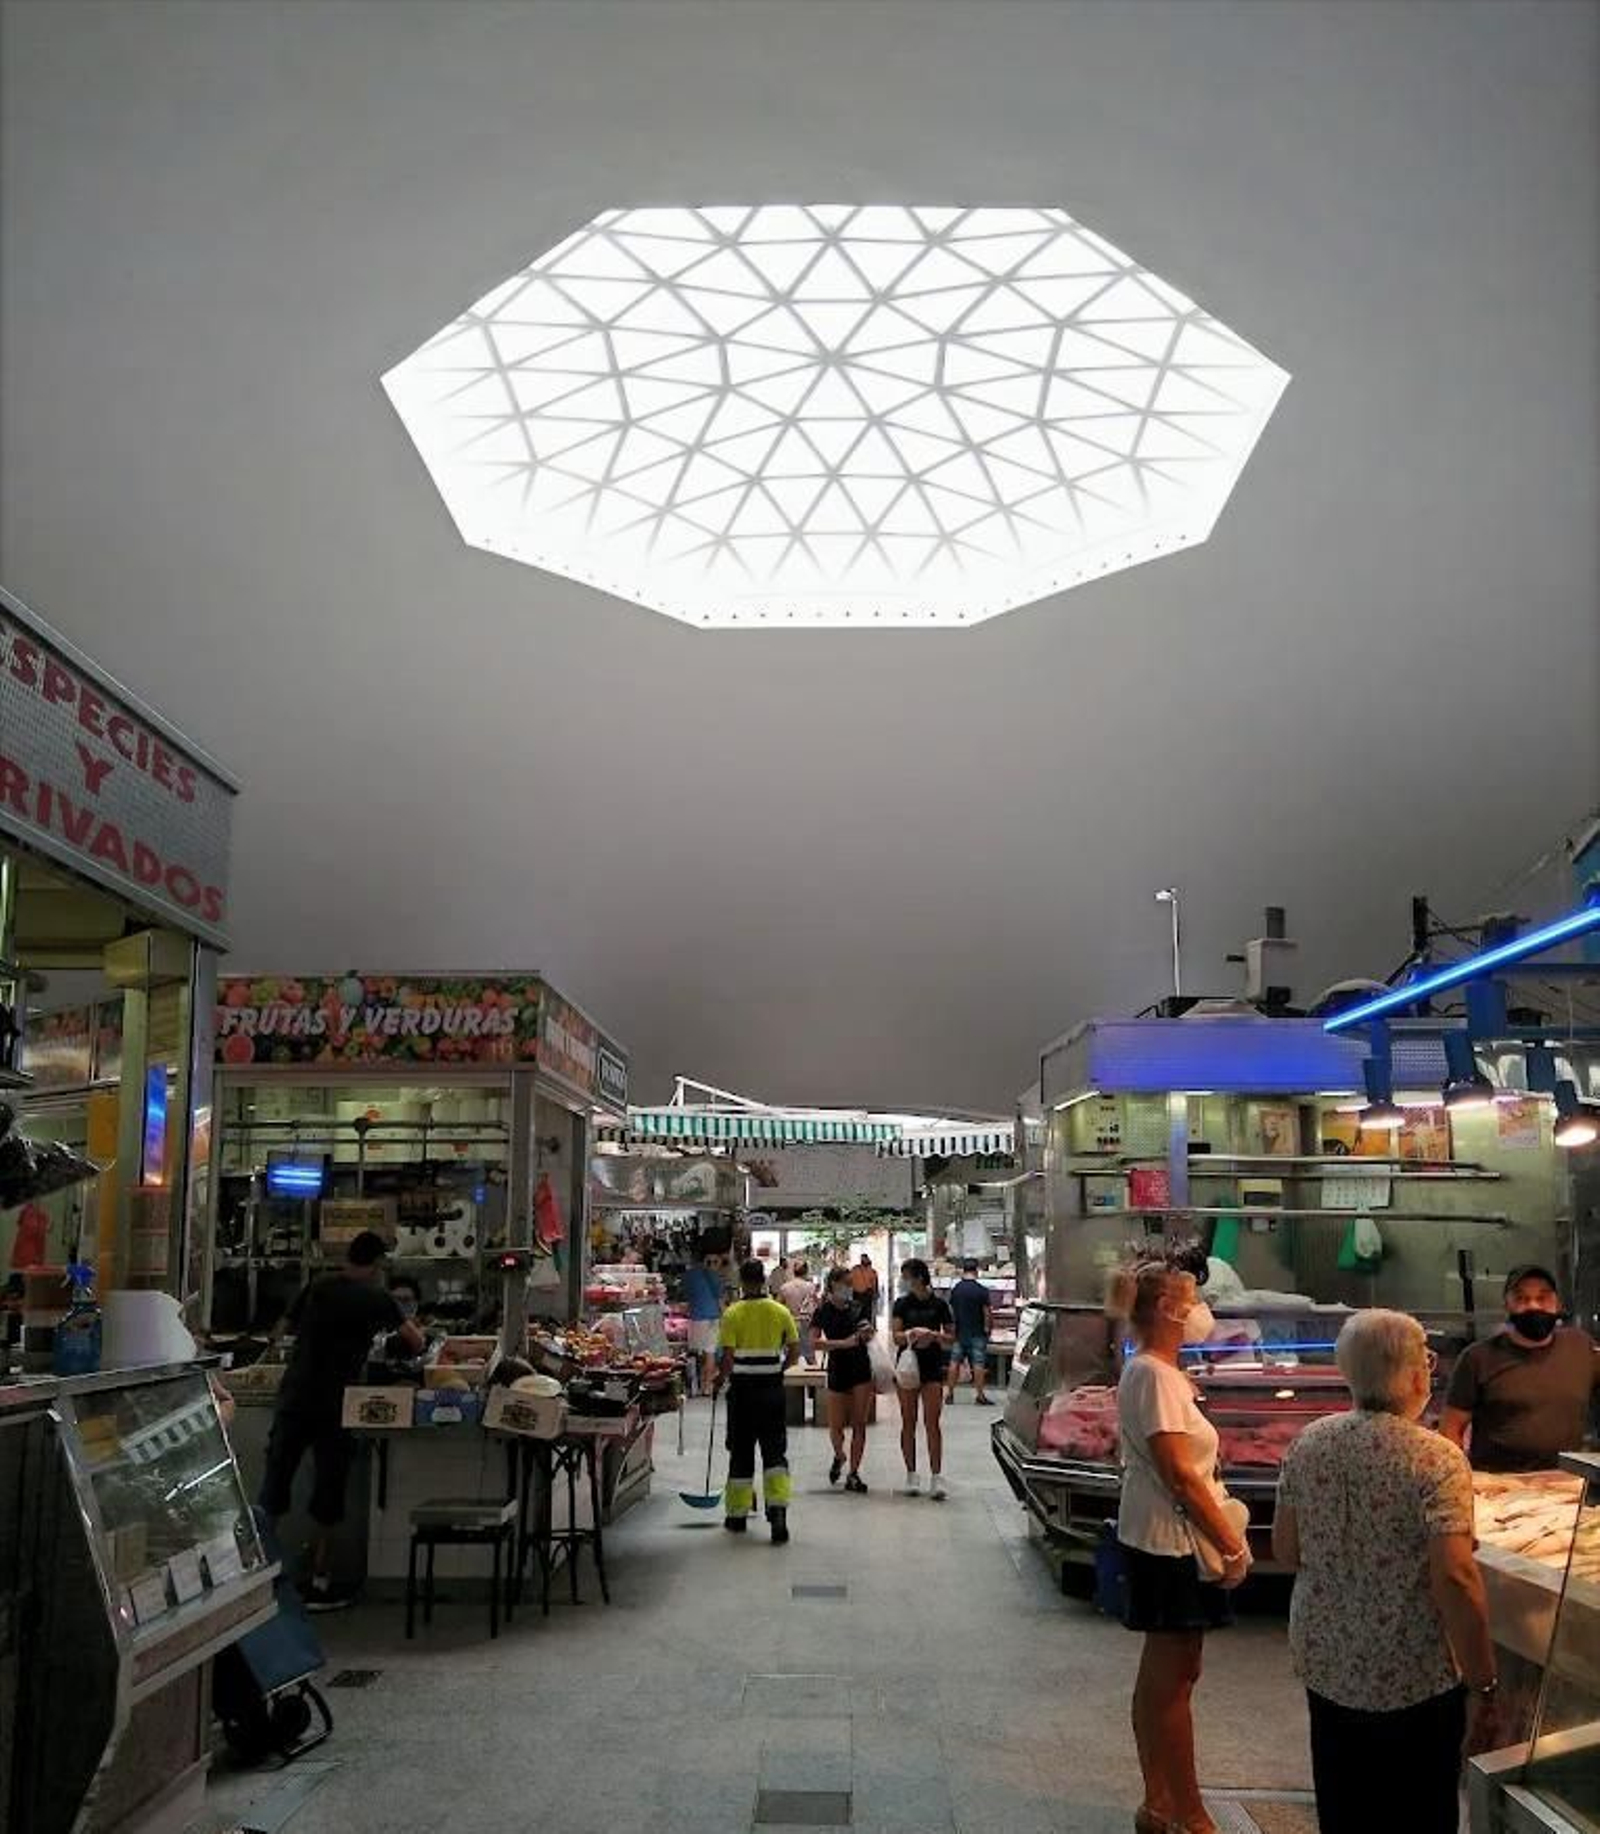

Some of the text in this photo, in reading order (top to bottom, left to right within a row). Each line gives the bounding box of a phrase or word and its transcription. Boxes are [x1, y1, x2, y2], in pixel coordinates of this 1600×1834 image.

[76, 742, 114, 795] Y
[220, 1007, 517, 1037] FRUTAS Y VERDURAS
